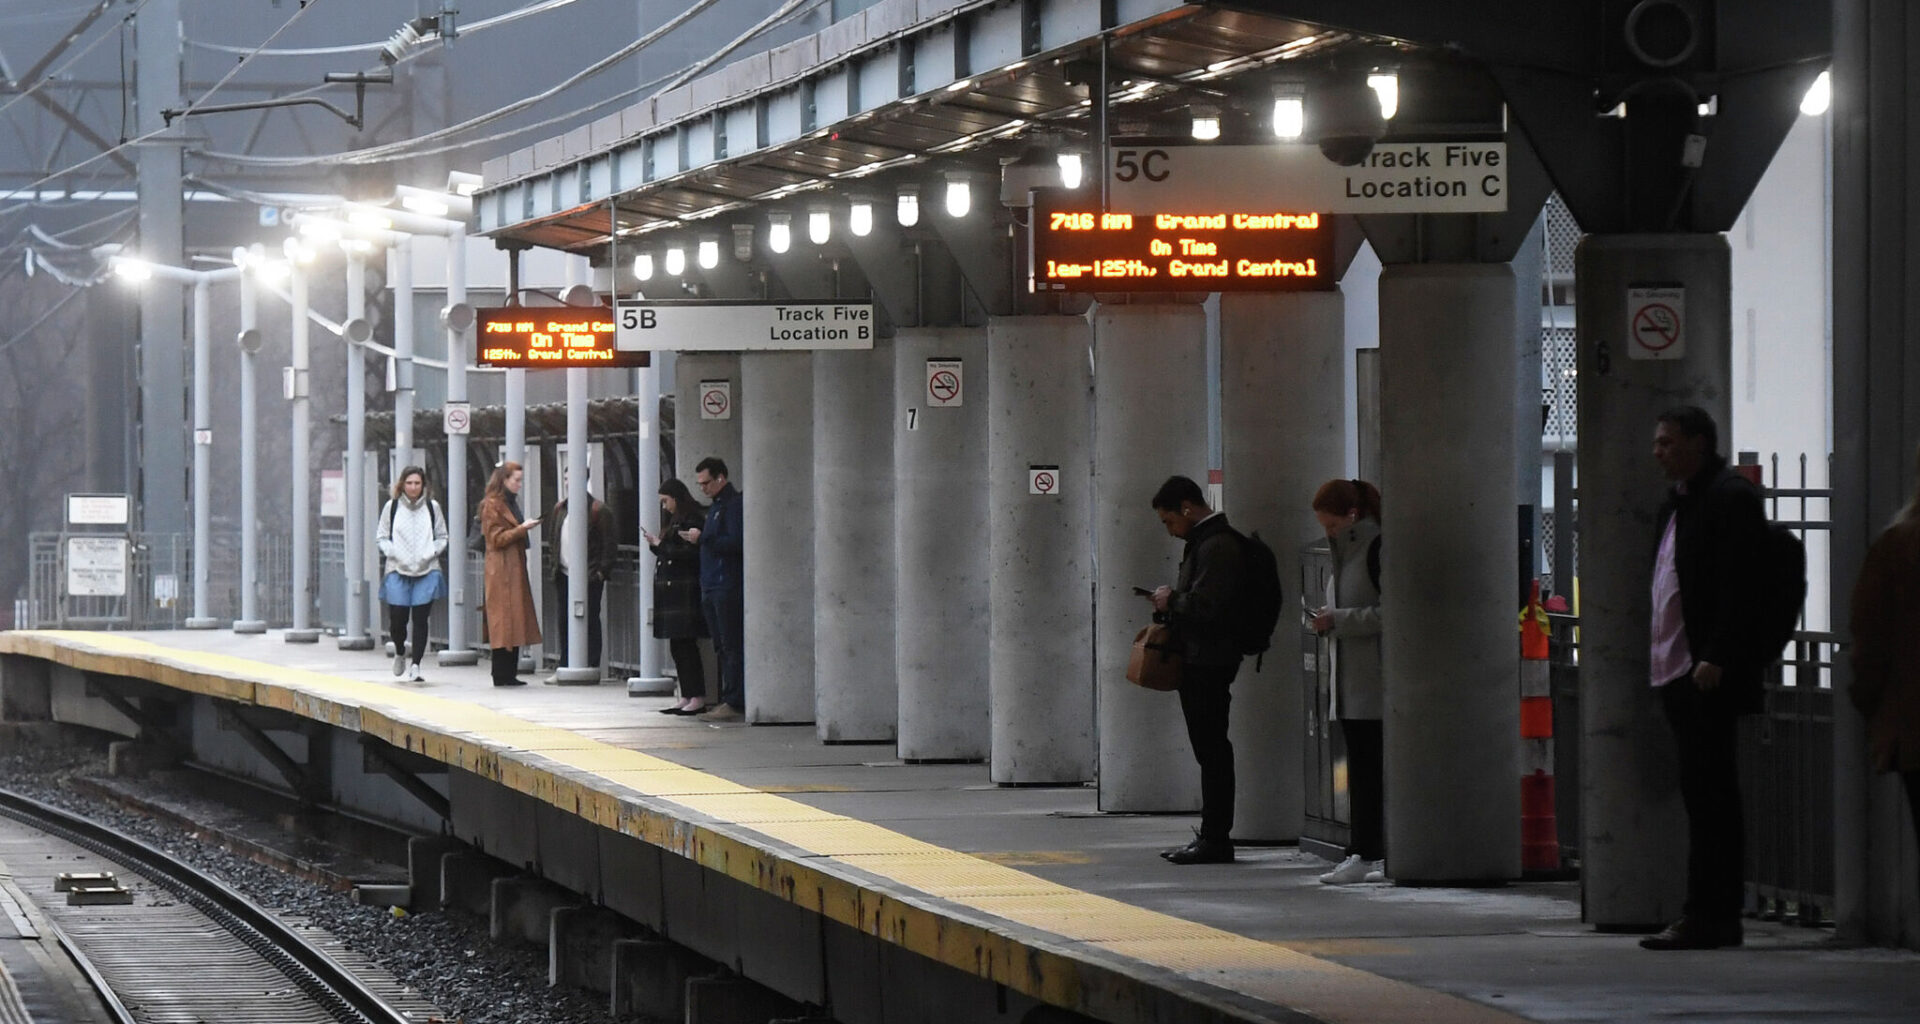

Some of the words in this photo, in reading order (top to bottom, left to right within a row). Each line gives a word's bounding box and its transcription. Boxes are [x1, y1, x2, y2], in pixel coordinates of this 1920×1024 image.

[1115, 149, 1171, 182] 5C
[1446, 146, 1500, 167] Five
[1345, 177, 1467, 198] Location
[1481, 174, 1500, 197] C
[1050, 213, 1095, 230] 7:16
[1101, 213, 1133, 230] AM
[1155, 214, 1227, 230] Grand
[1233, 212, 1319, 229] Central
[1150, 239, 1172, 256] On
[1179, 238, 1217, 256] Time
[1169, 260, 1229, 278] Grand
[1237, 258, 1317, 278] Central
[622, 309, 657, 330] 5B
[775, 307, 824, 321] Track
[834, 307, 869, 320] Five
[547, 321, 589, 333] Grand
[771, 326, 848, 340] Location
[858, 326, 869, 339] B
[530, 332, 553, 348] On
[560, 332, 595, 348] Time
[484, 349, 522, 361] 125th,
[527, 349, 563, 360] Grand
[566, 348, 614, 360] Central
[908, 408, 917, 430] 7
